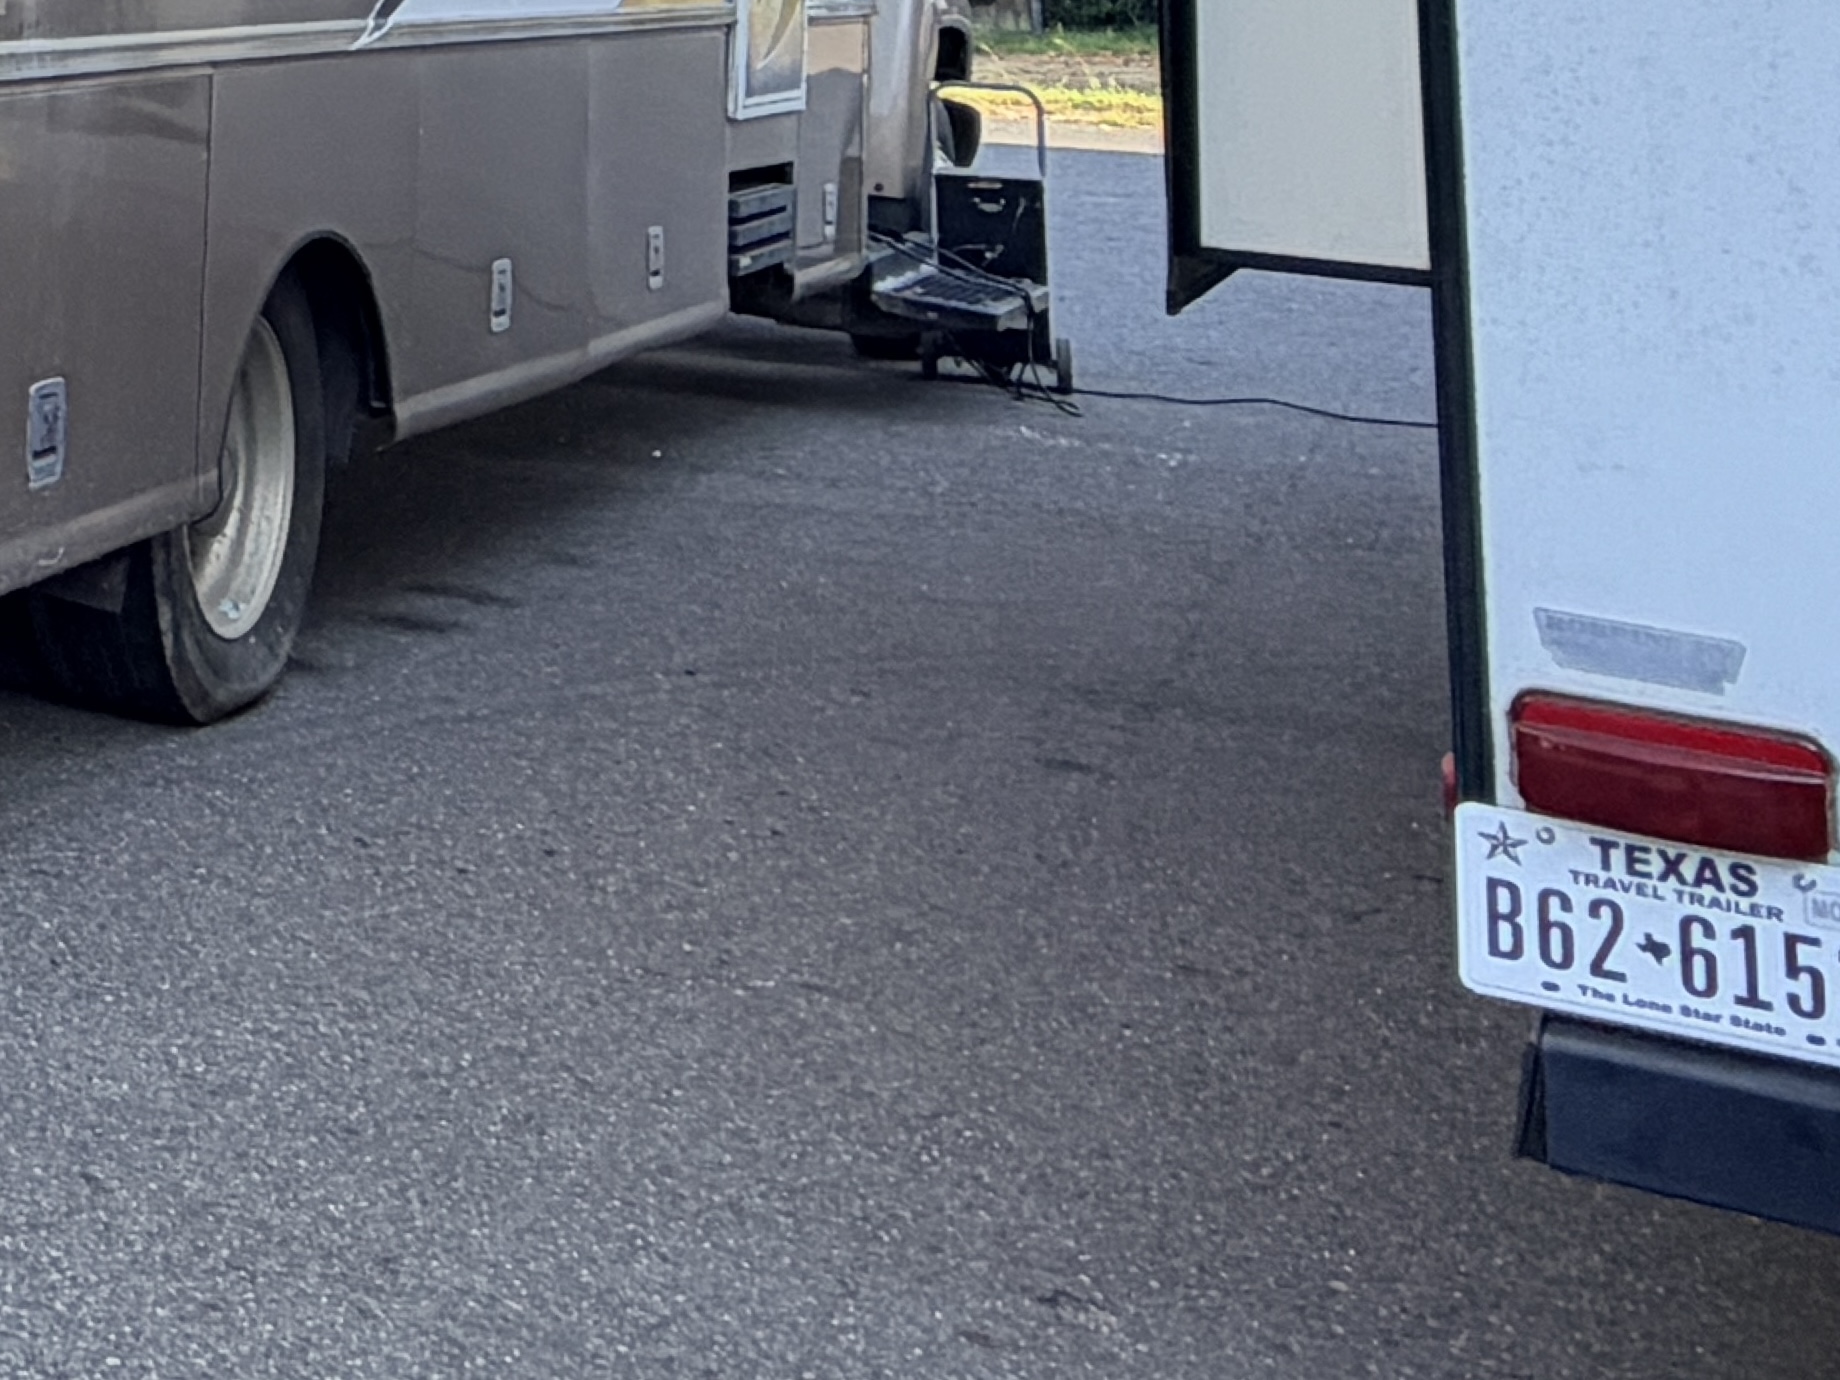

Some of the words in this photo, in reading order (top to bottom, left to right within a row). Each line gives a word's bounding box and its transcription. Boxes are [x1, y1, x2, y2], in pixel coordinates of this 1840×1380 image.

[1568, 869, 1666, 902] TRAVEL
[1673, 889, 1785, 923] TRAILER
[1588, 836, 1760, 899] TEXAS
[1485, 876, 1628, 984] B62
[1678, 914, 1827, 1021] 615
[1576, 983, 1617, 1004] The
[1621, 992, 1672, 1016] Lone
[1678, 1004, 1724, 1025] Star
